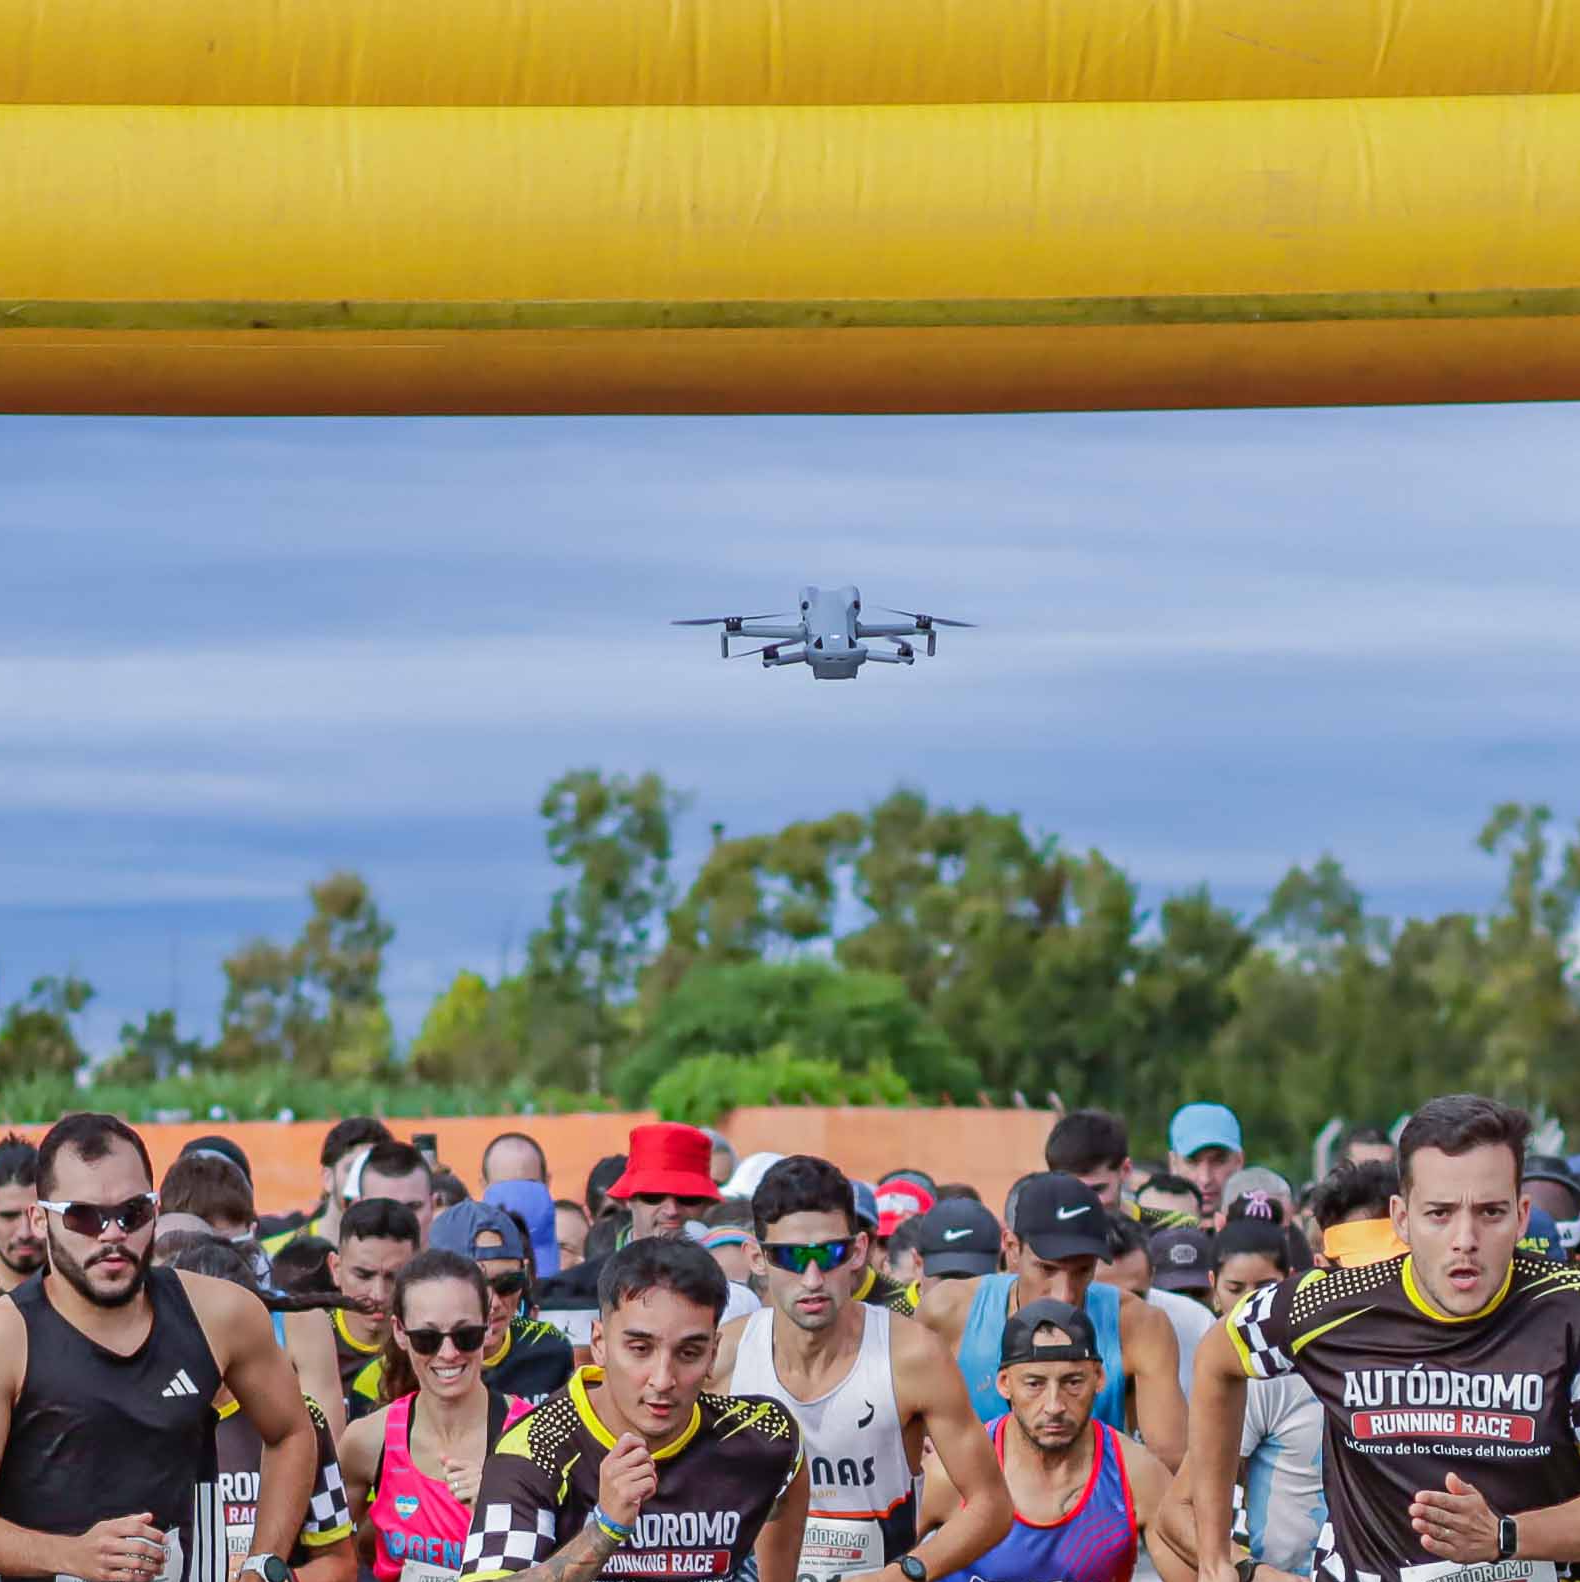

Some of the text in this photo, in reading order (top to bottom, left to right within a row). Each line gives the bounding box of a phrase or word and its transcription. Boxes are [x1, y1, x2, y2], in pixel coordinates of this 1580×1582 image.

[1343, 1363, 1544, 1412] AUTÓDROMO
[1370, 1413, 1513, 1438] RUNNING RACE
[1354, 1443, 1393, 1455] Carrera
[1396, 1443, 1411, 1454] de
[1414, 1444, 1430, 1454] los
[1433, 1444, 1472, 1457] Clubes
[1475, 1445, 1494, 1457] del
[1497, 1446, 1550, 1457] Noroeste
[670, 1553, 714, 1573] RACE
